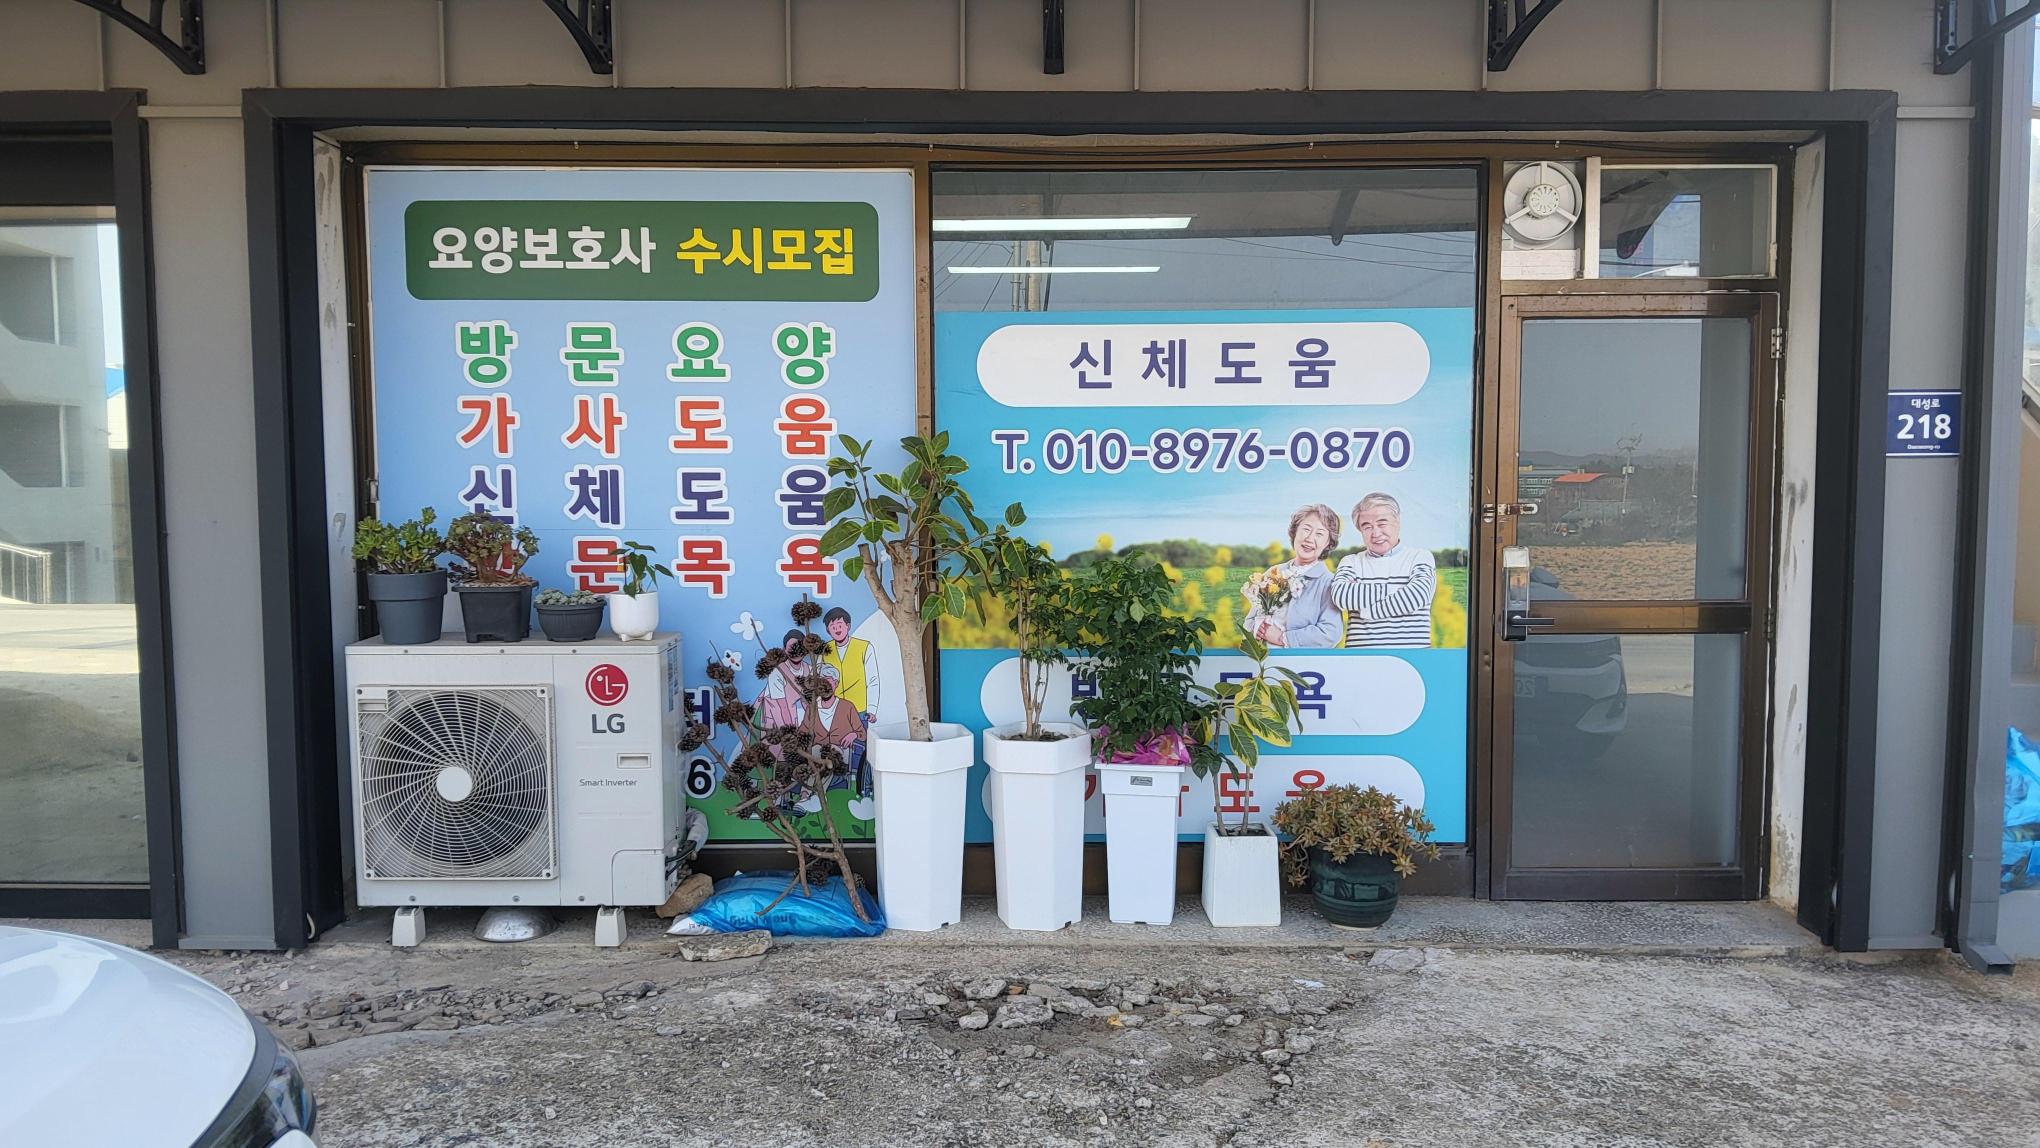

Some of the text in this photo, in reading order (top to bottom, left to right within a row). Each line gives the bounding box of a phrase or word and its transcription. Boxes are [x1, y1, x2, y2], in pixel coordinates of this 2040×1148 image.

[428, 225, 854, 275] 요양보호사 수시모집
[1911, 398, 1941, 410] 대성로
[1897, 413, 1952, 439] 218
[995, 430, 1411, 473] T. 010-8976-0870
[592, 713, 626, 734] LG
[580, 779, 637, 787] Smart Inverter
